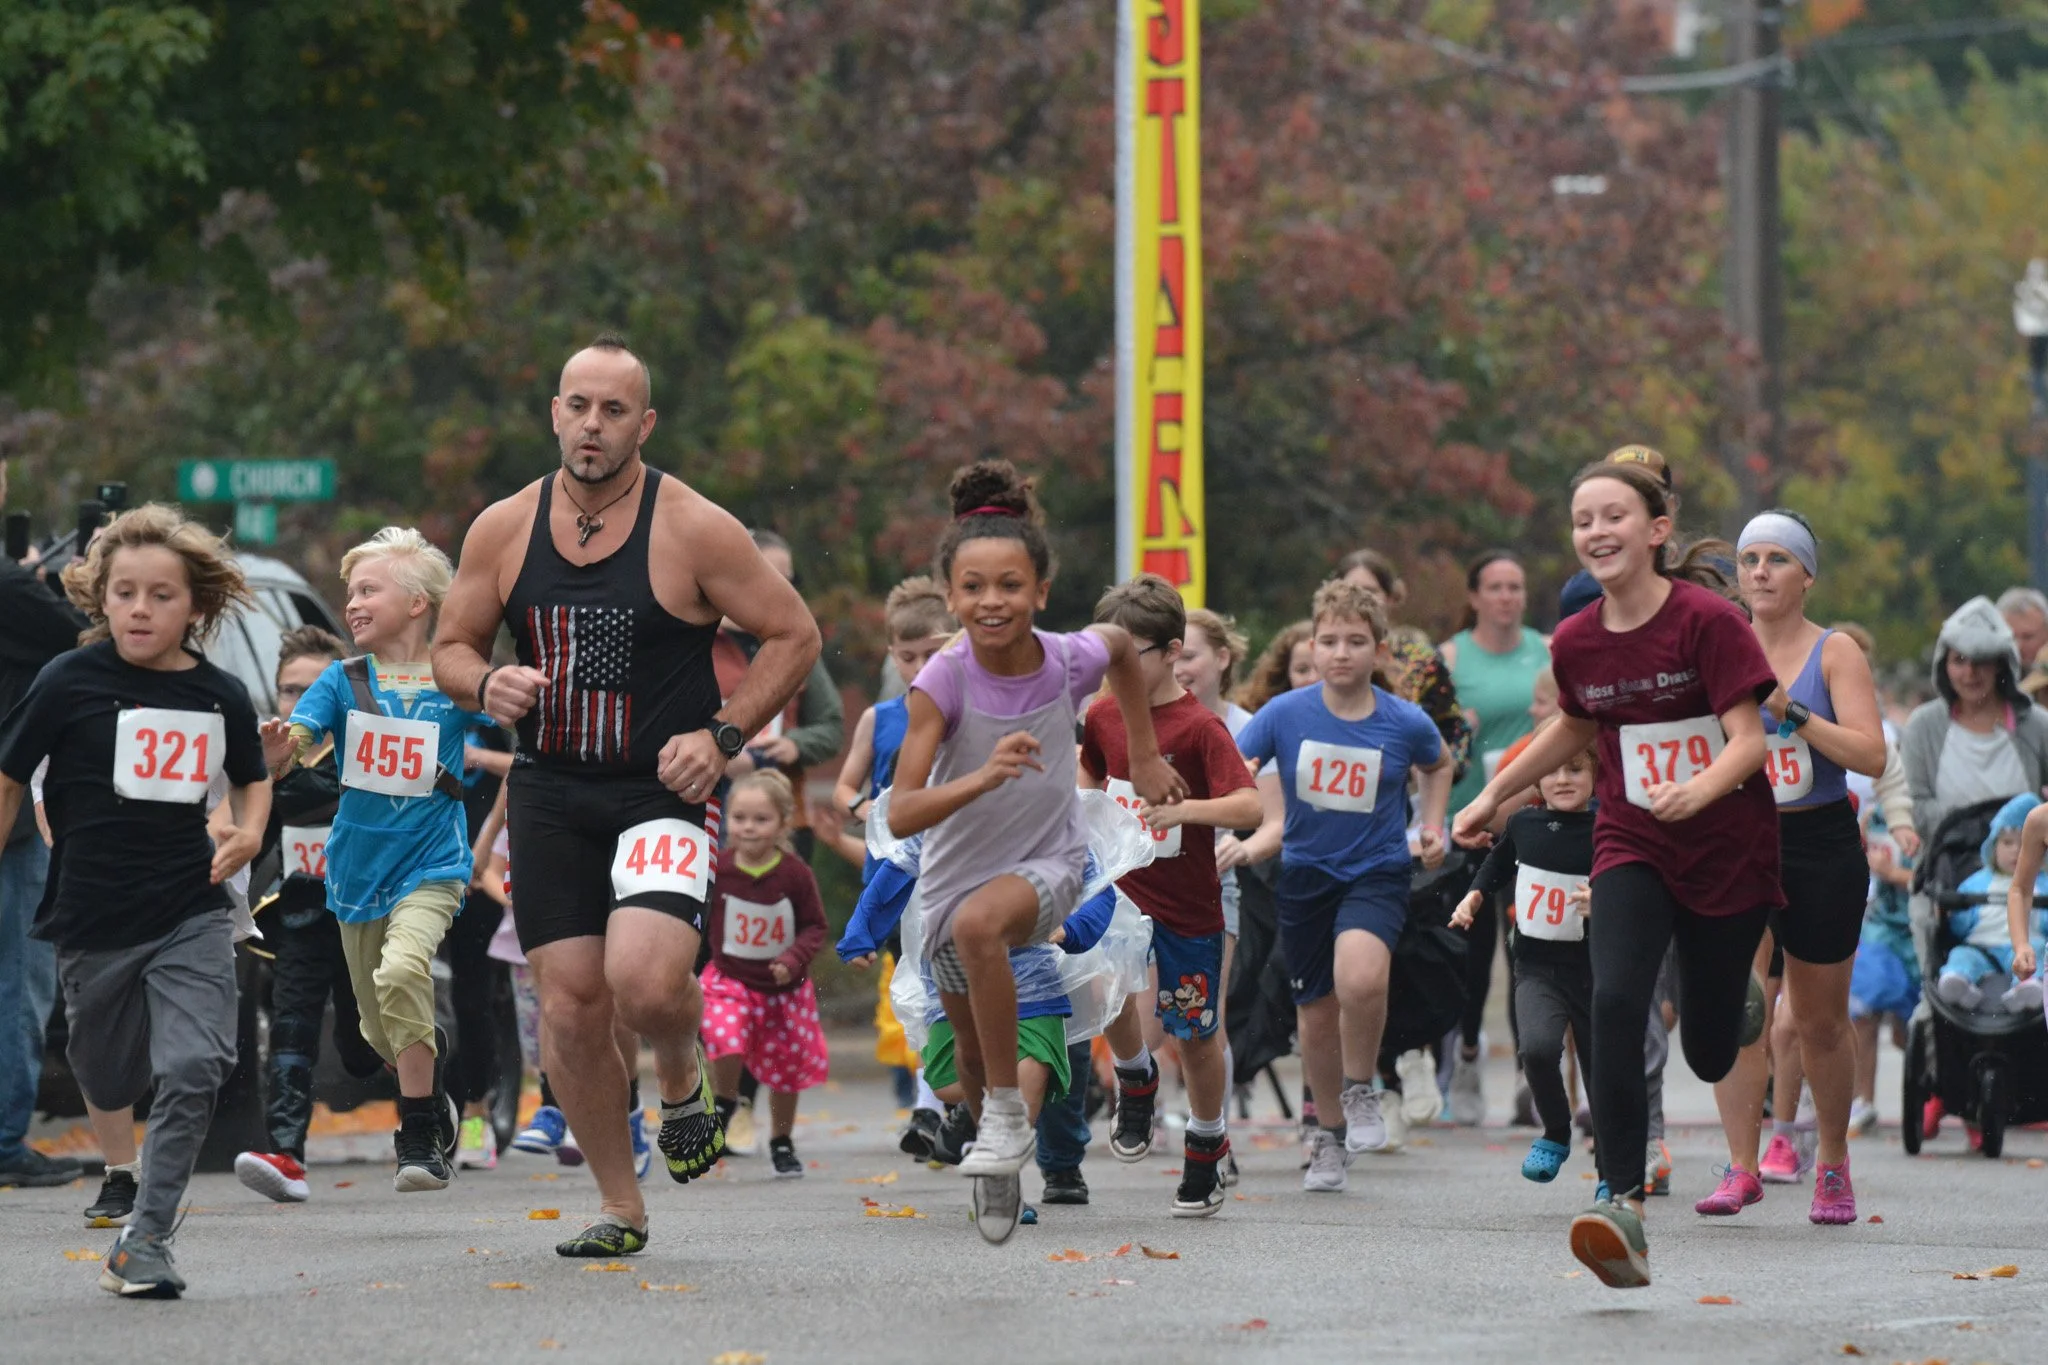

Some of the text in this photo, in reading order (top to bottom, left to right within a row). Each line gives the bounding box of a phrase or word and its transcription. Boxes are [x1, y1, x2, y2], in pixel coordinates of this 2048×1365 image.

[229, 461, 323, 498] CHURCH
[133, 727, 209, 783] 321
[356, 731, 425, 781] 455
[1309, 757, 1367, 798] 126
[1637, 735, 1713, 790] 379
[625, 833, 698, 880] 442
[1526, 883, 1567, 926] 79
[734, 913, 786, 947] 324
